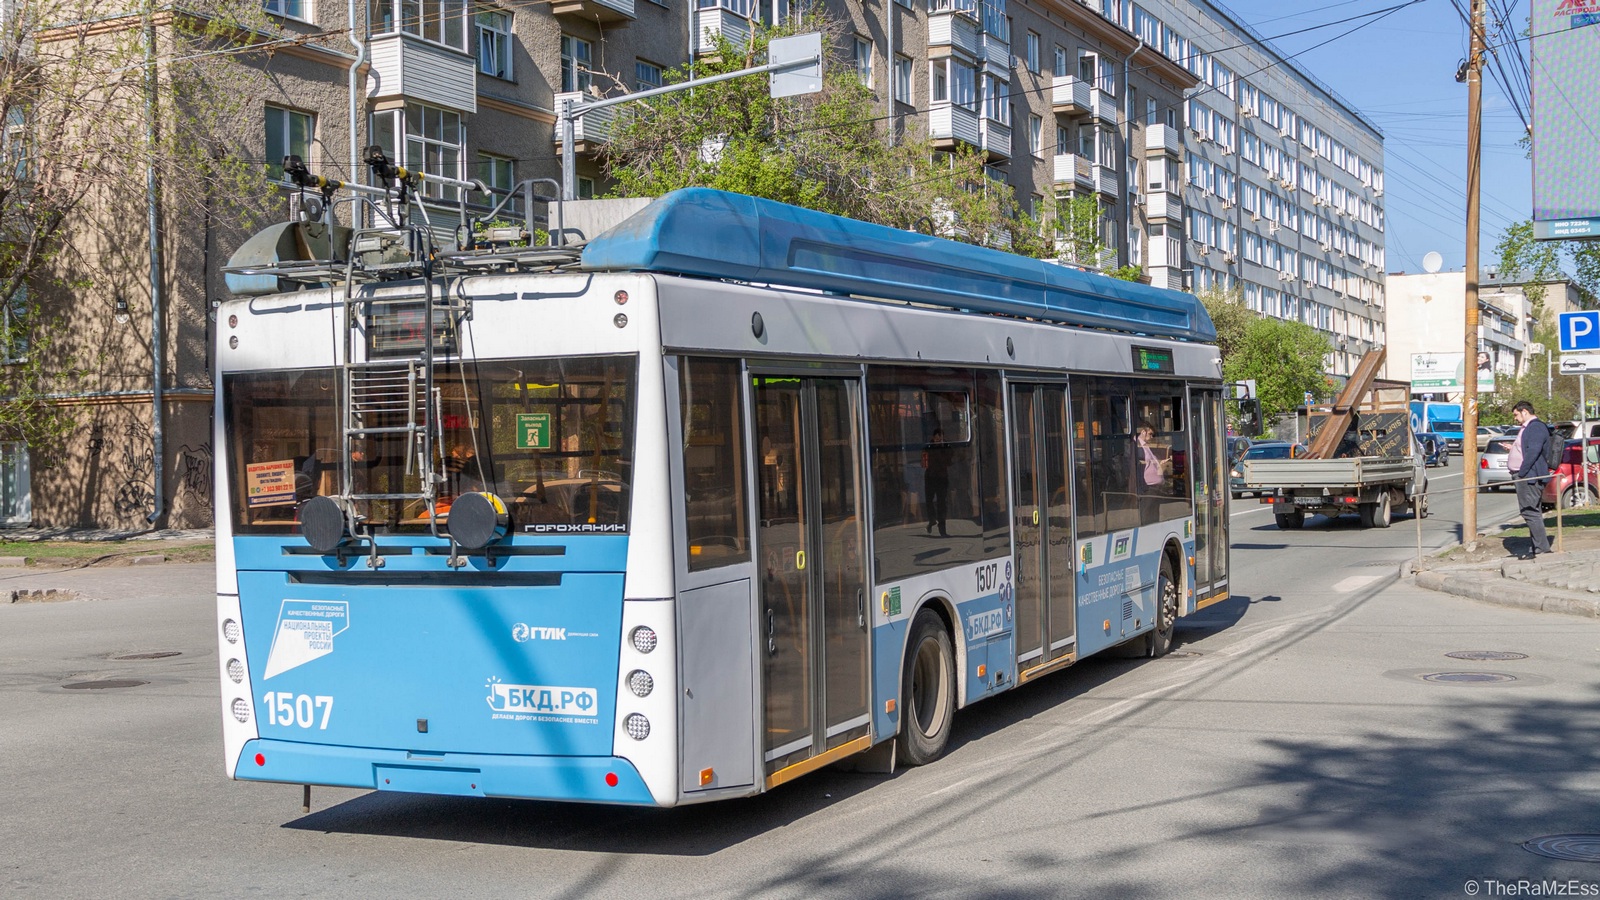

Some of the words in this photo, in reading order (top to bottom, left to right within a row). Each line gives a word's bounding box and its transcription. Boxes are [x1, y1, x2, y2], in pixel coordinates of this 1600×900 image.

[524, 524, 626, 532] ГОРОЖАНИН
[974, 563, 998, 593] 1507
[1098, 568, 1124, 586] БЕЗОПАСНЫЕ
[1078, 587, 1110, 607] КАЧЕСТВЕННЫЕ
[284, 621, 331, 631] НАЦИОНАЛЬНЫЕ
[974, 611, 1001, 635] БКД.РФ
[303, 631, 331, 641] ПРОЕКТЫ
[530, 627, 566, 640] ГТЛК
[309, 641, 332, 650] РОССИИ
[508, 688, 593, 711] БКД.РФ
[263, 691, 333, 730] 1507
